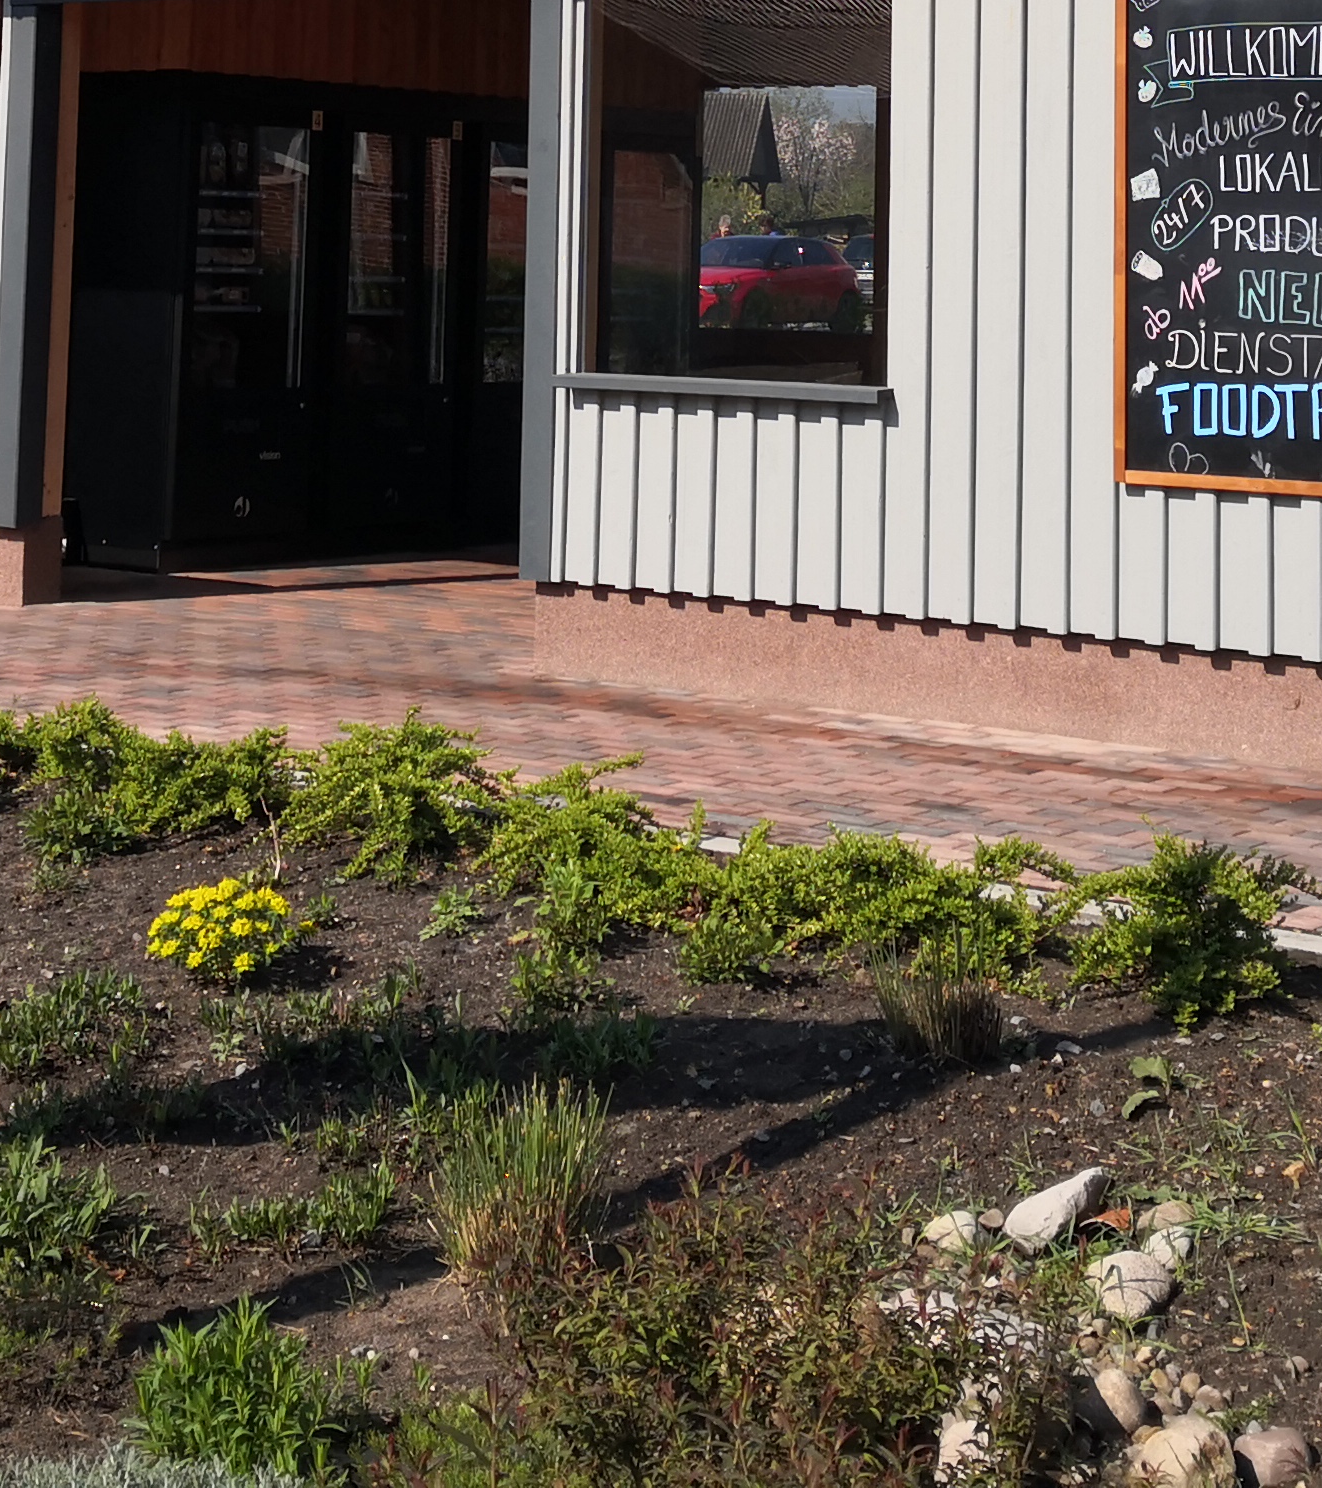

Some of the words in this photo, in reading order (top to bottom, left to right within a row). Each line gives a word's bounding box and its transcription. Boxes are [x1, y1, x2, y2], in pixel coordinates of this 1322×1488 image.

[1152, 101, 1286, 167] Modernes
[1154, 183, 1205, 246] 24/7
[1142, 305, 1171, 341] ab
